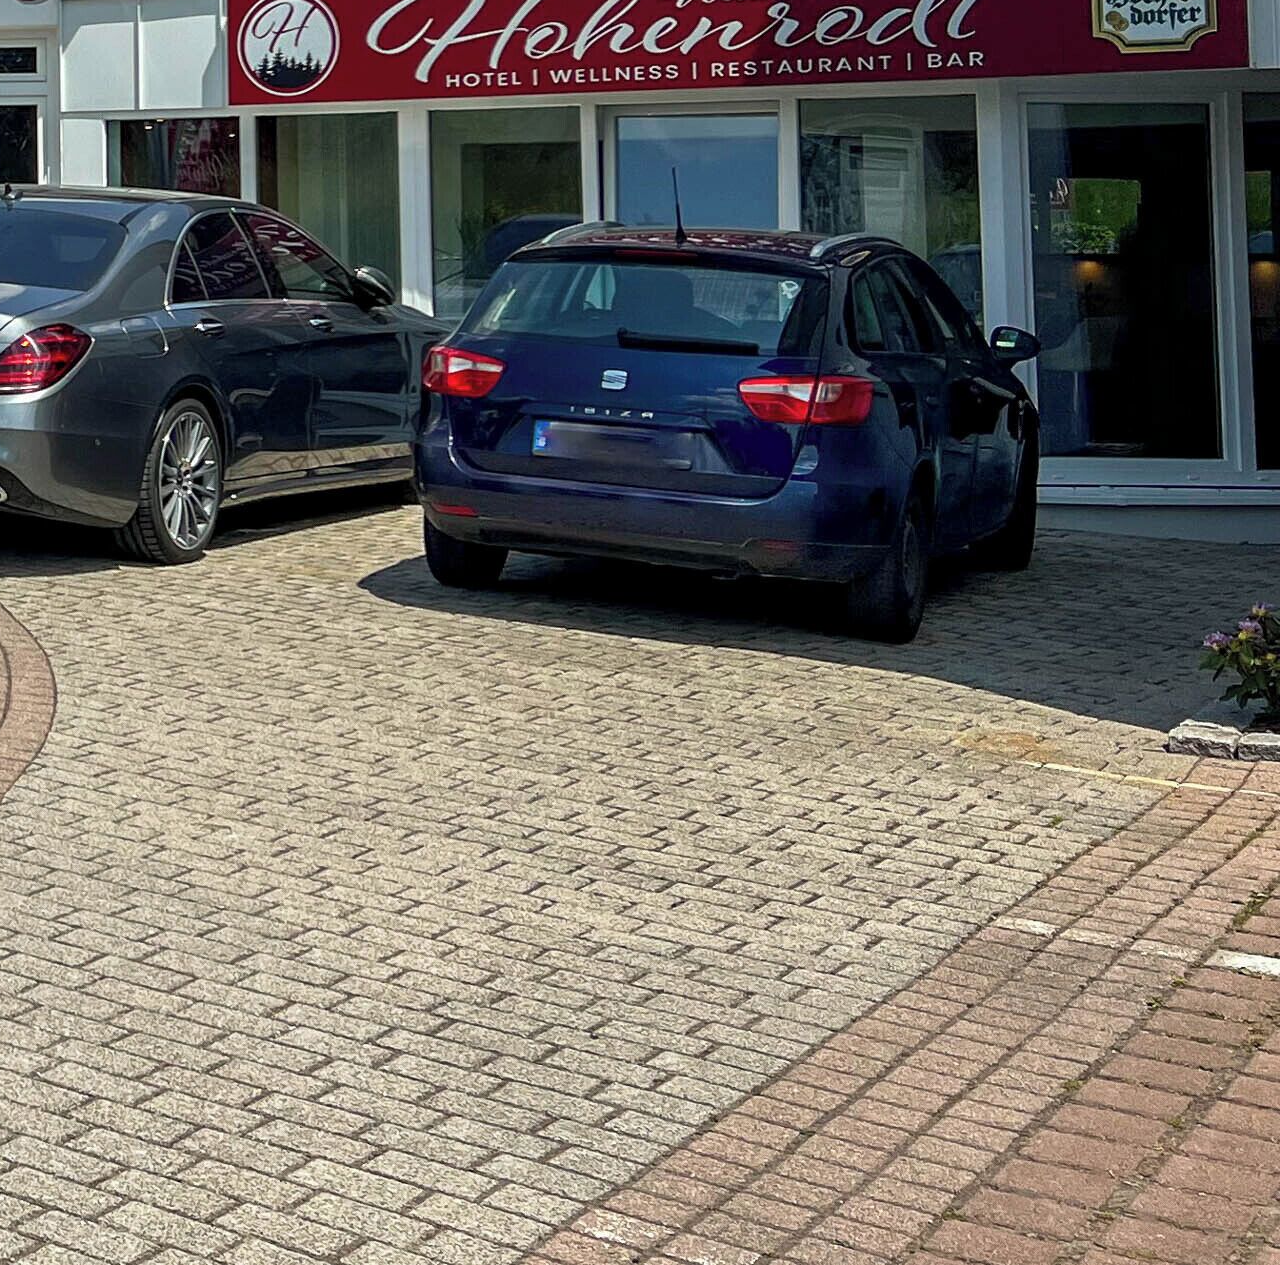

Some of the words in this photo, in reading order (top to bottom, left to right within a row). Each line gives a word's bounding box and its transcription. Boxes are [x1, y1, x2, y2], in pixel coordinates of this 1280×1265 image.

[1130, 2, 1201, 31] dorfer
[446, 71, 521, 88] HOTEL
[550, 64, 679, 84] WELLNESS
[711, 55, 892, 78] RESTAURANT
[927, 51, 984, 68] BAR
